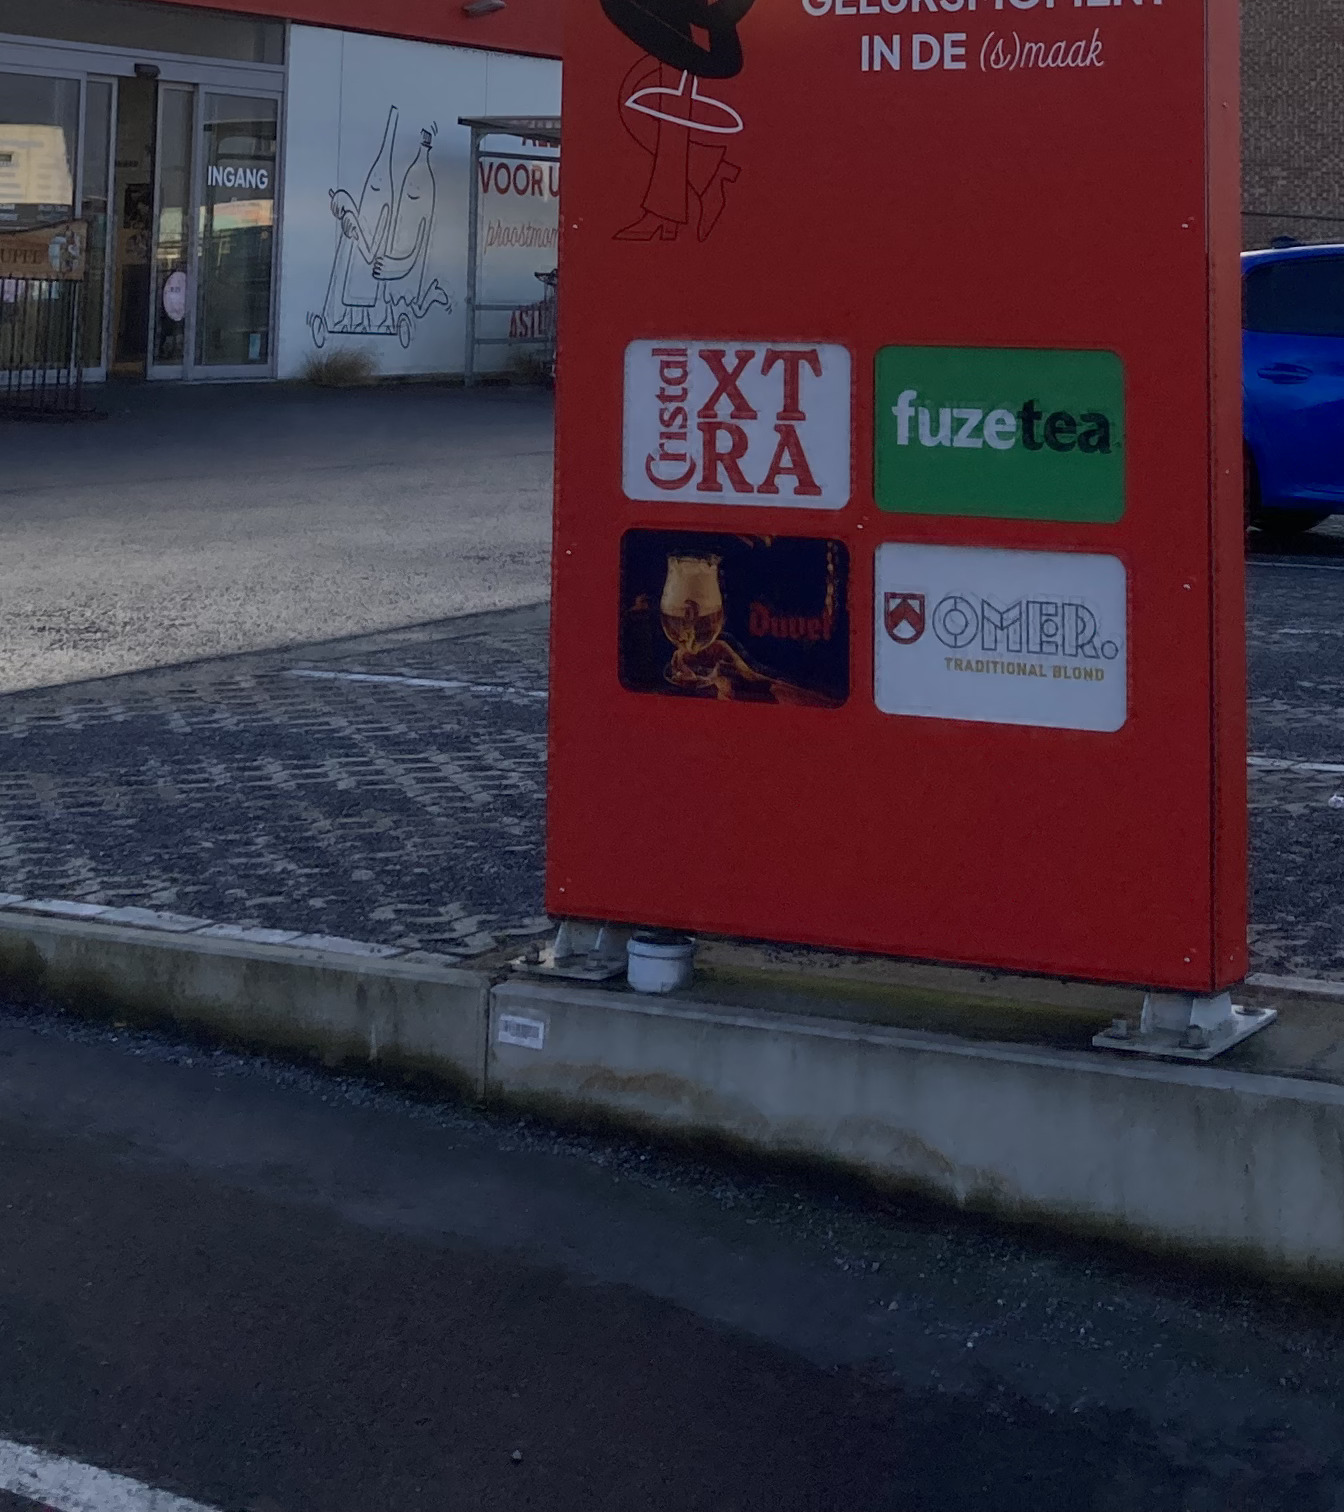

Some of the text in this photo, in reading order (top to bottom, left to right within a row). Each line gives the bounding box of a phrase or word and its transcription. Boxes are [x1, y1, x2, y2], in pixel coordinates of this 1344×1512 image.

[861, 28, 1105, 72] IN DE (s)maak
[207, 166, 269, 189] INGANG
[479, 161, 544, 196] VOOR
[645, 348, 697, 490] Cristal
[944, 656, 1105, 682] TRADITIONAL BLOND
